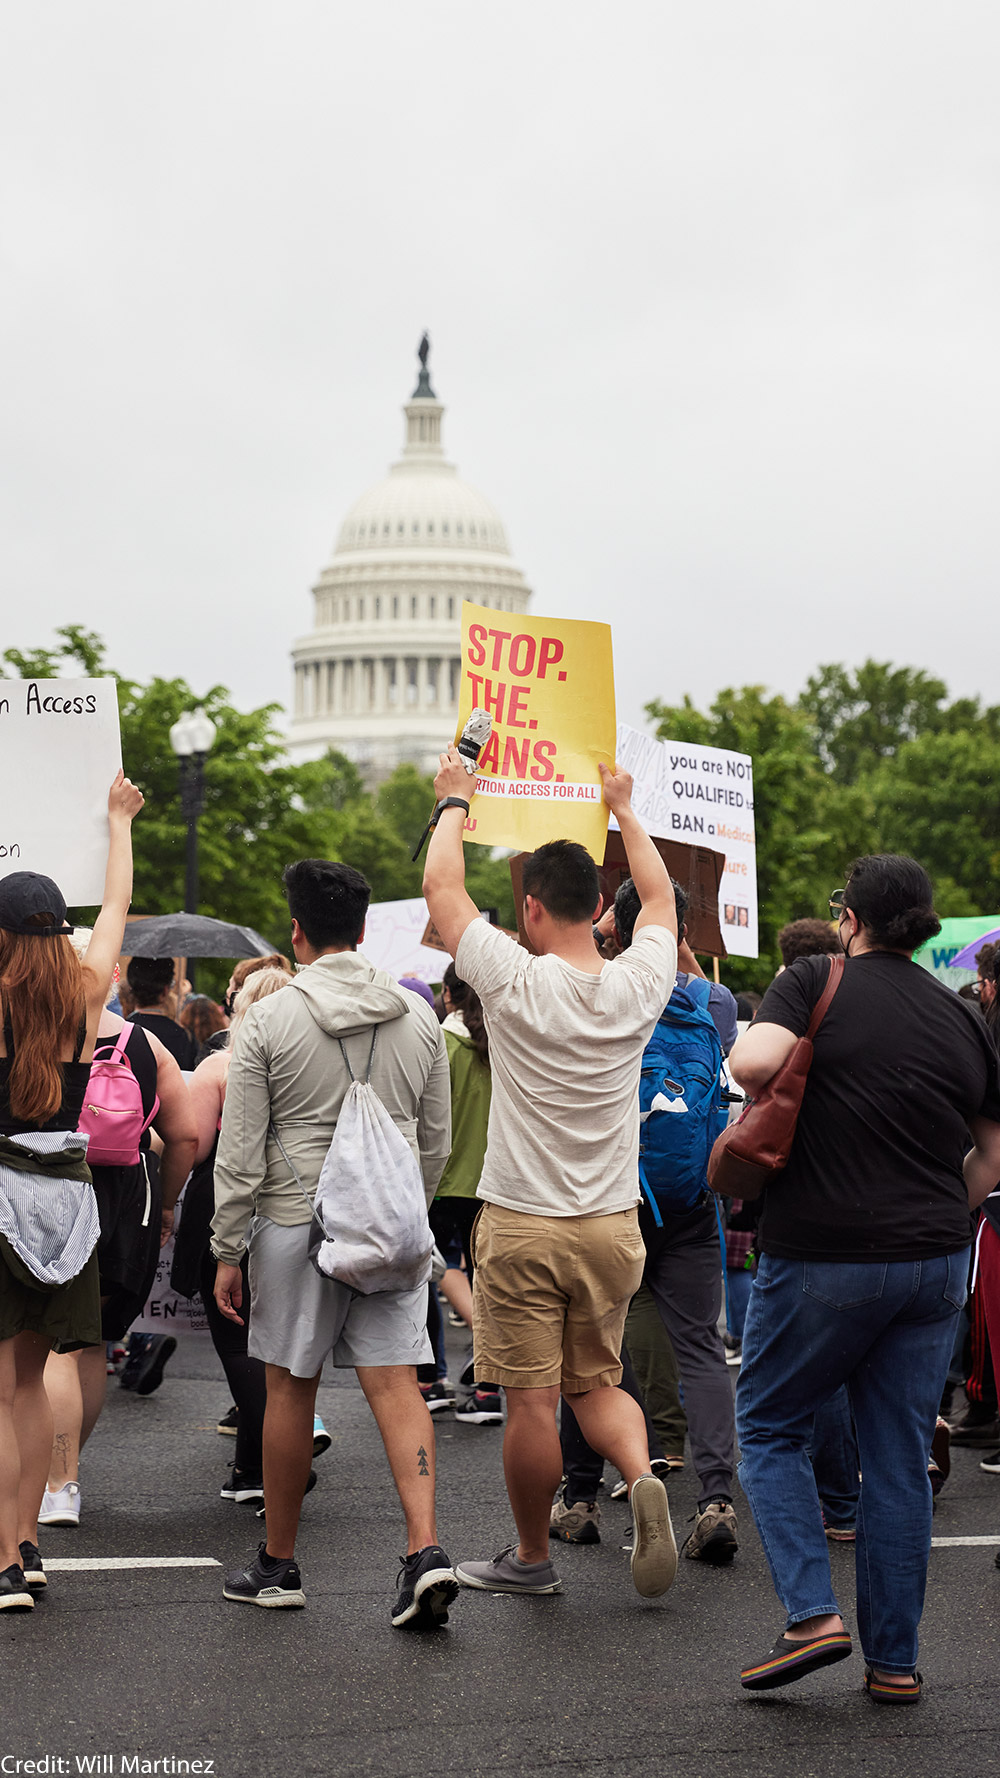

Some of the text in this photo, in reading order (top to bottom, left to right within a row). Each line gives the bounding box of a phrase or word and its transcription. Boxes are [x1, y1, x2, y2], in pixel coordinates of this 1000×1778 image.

[467, 623, 568, 682] STOP.
[26, 682, 97, 716] Access
[466, 670, 539, 730] THE.
[476, 730, 566, 783] ANS.
[670, 755, 752, 780] you are NOT
[475, 778, 597, 799] RTION ACCESS FOR ALL
[672, 780, 744, 808] QUALIFIED
[671, 812, 704, 833] BAN
[707, 823, 715, 835] a
[141, 1300, 178, 1319] EN
